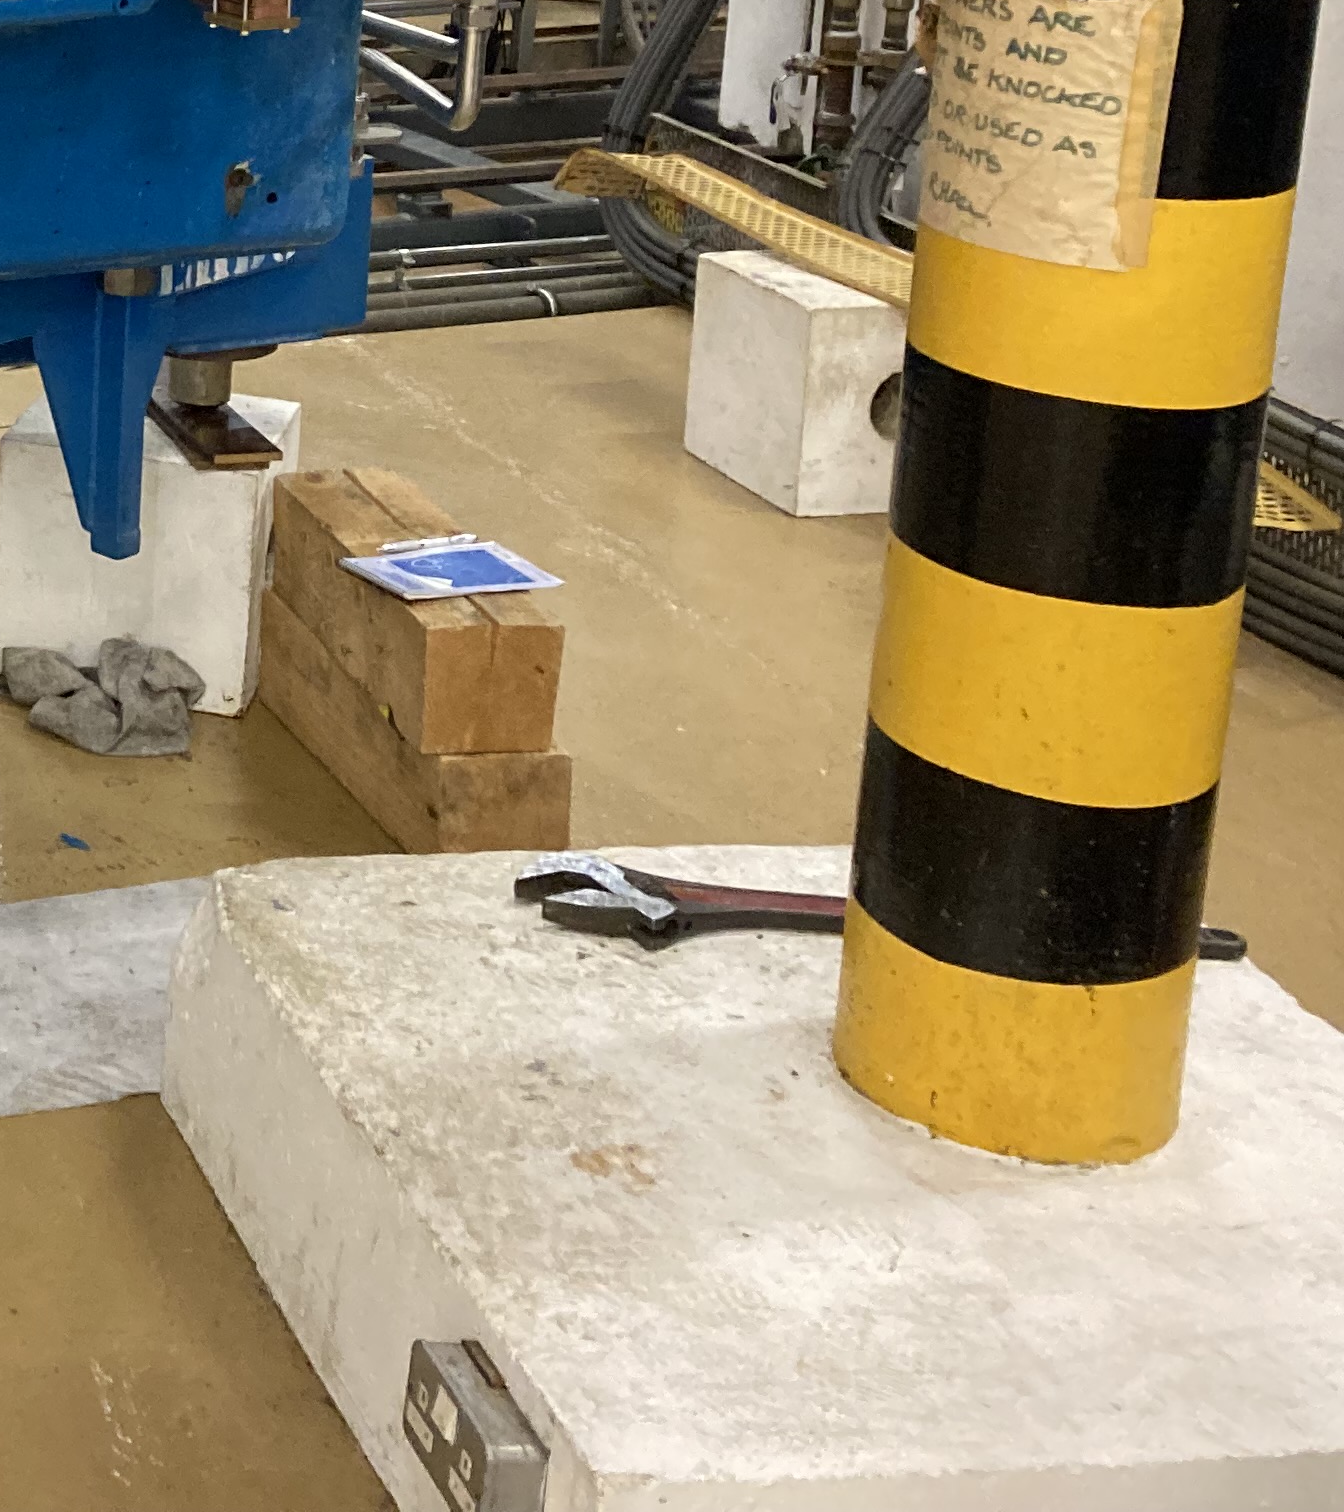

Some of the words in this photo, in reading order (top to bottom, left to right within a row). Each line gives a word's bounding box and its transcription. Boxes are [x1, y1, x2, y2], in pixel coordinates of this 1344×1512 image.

[1028, 5, 1096, 37] ARE
[1006, 38, 1068, 66] AND
[987, 67, 1122, 116] KNOCKED
[975, 112, 1043, 147] USED
[1052, 134, 1097, 159] AS
